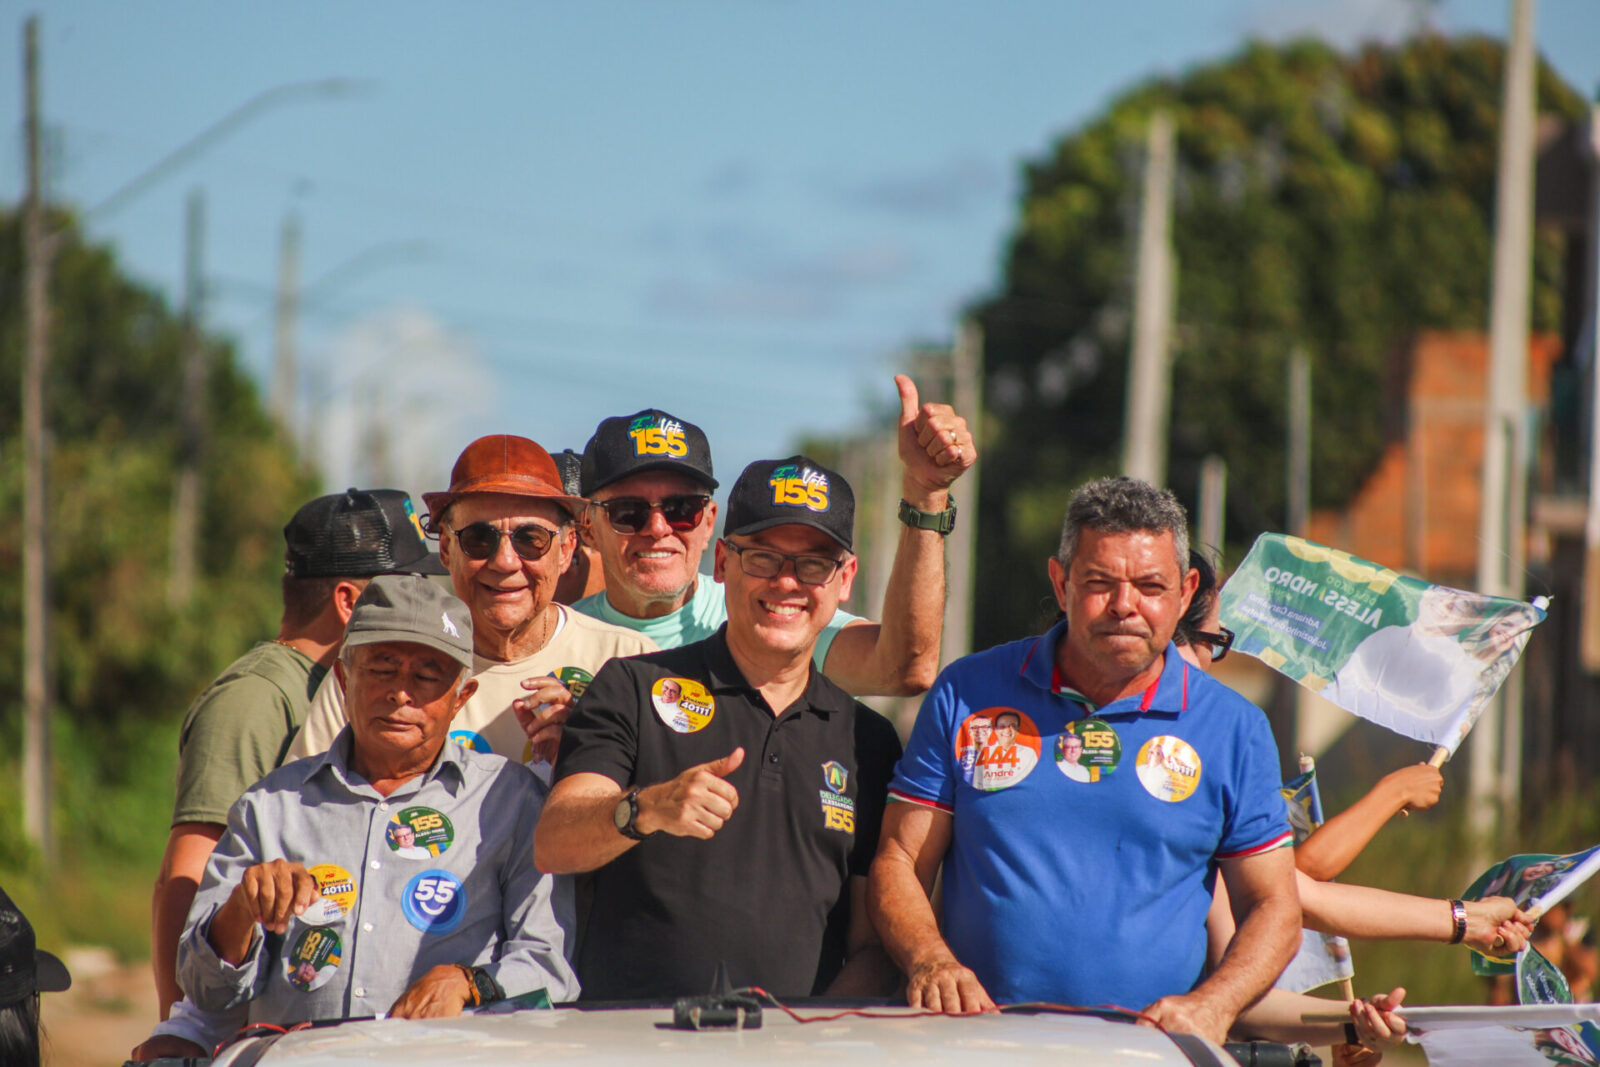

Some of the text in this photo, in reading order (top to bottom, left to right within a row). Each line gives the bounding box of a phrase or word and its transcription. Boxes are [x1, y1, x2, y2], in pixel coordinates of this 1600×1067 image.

[630, 427, 688, 457] 155
[770, 477, 828, 510] 155
[568, 680, 590, 697] 15
[681, 701, 710, 716] 40111
[1081, 730, 1115, 748] 155
[976, 745, 1020, 769] 444
[983, 769, 1014, 778] André
[820, 790, 853, 806] DELEGADO
[409, 813, 443, 832] 155
[822, 804, 855, 833] 155
[323, 883, 352, 895] 40111
[415, 879, 456, 904] 55
[299, 930, 322, 961] 155
